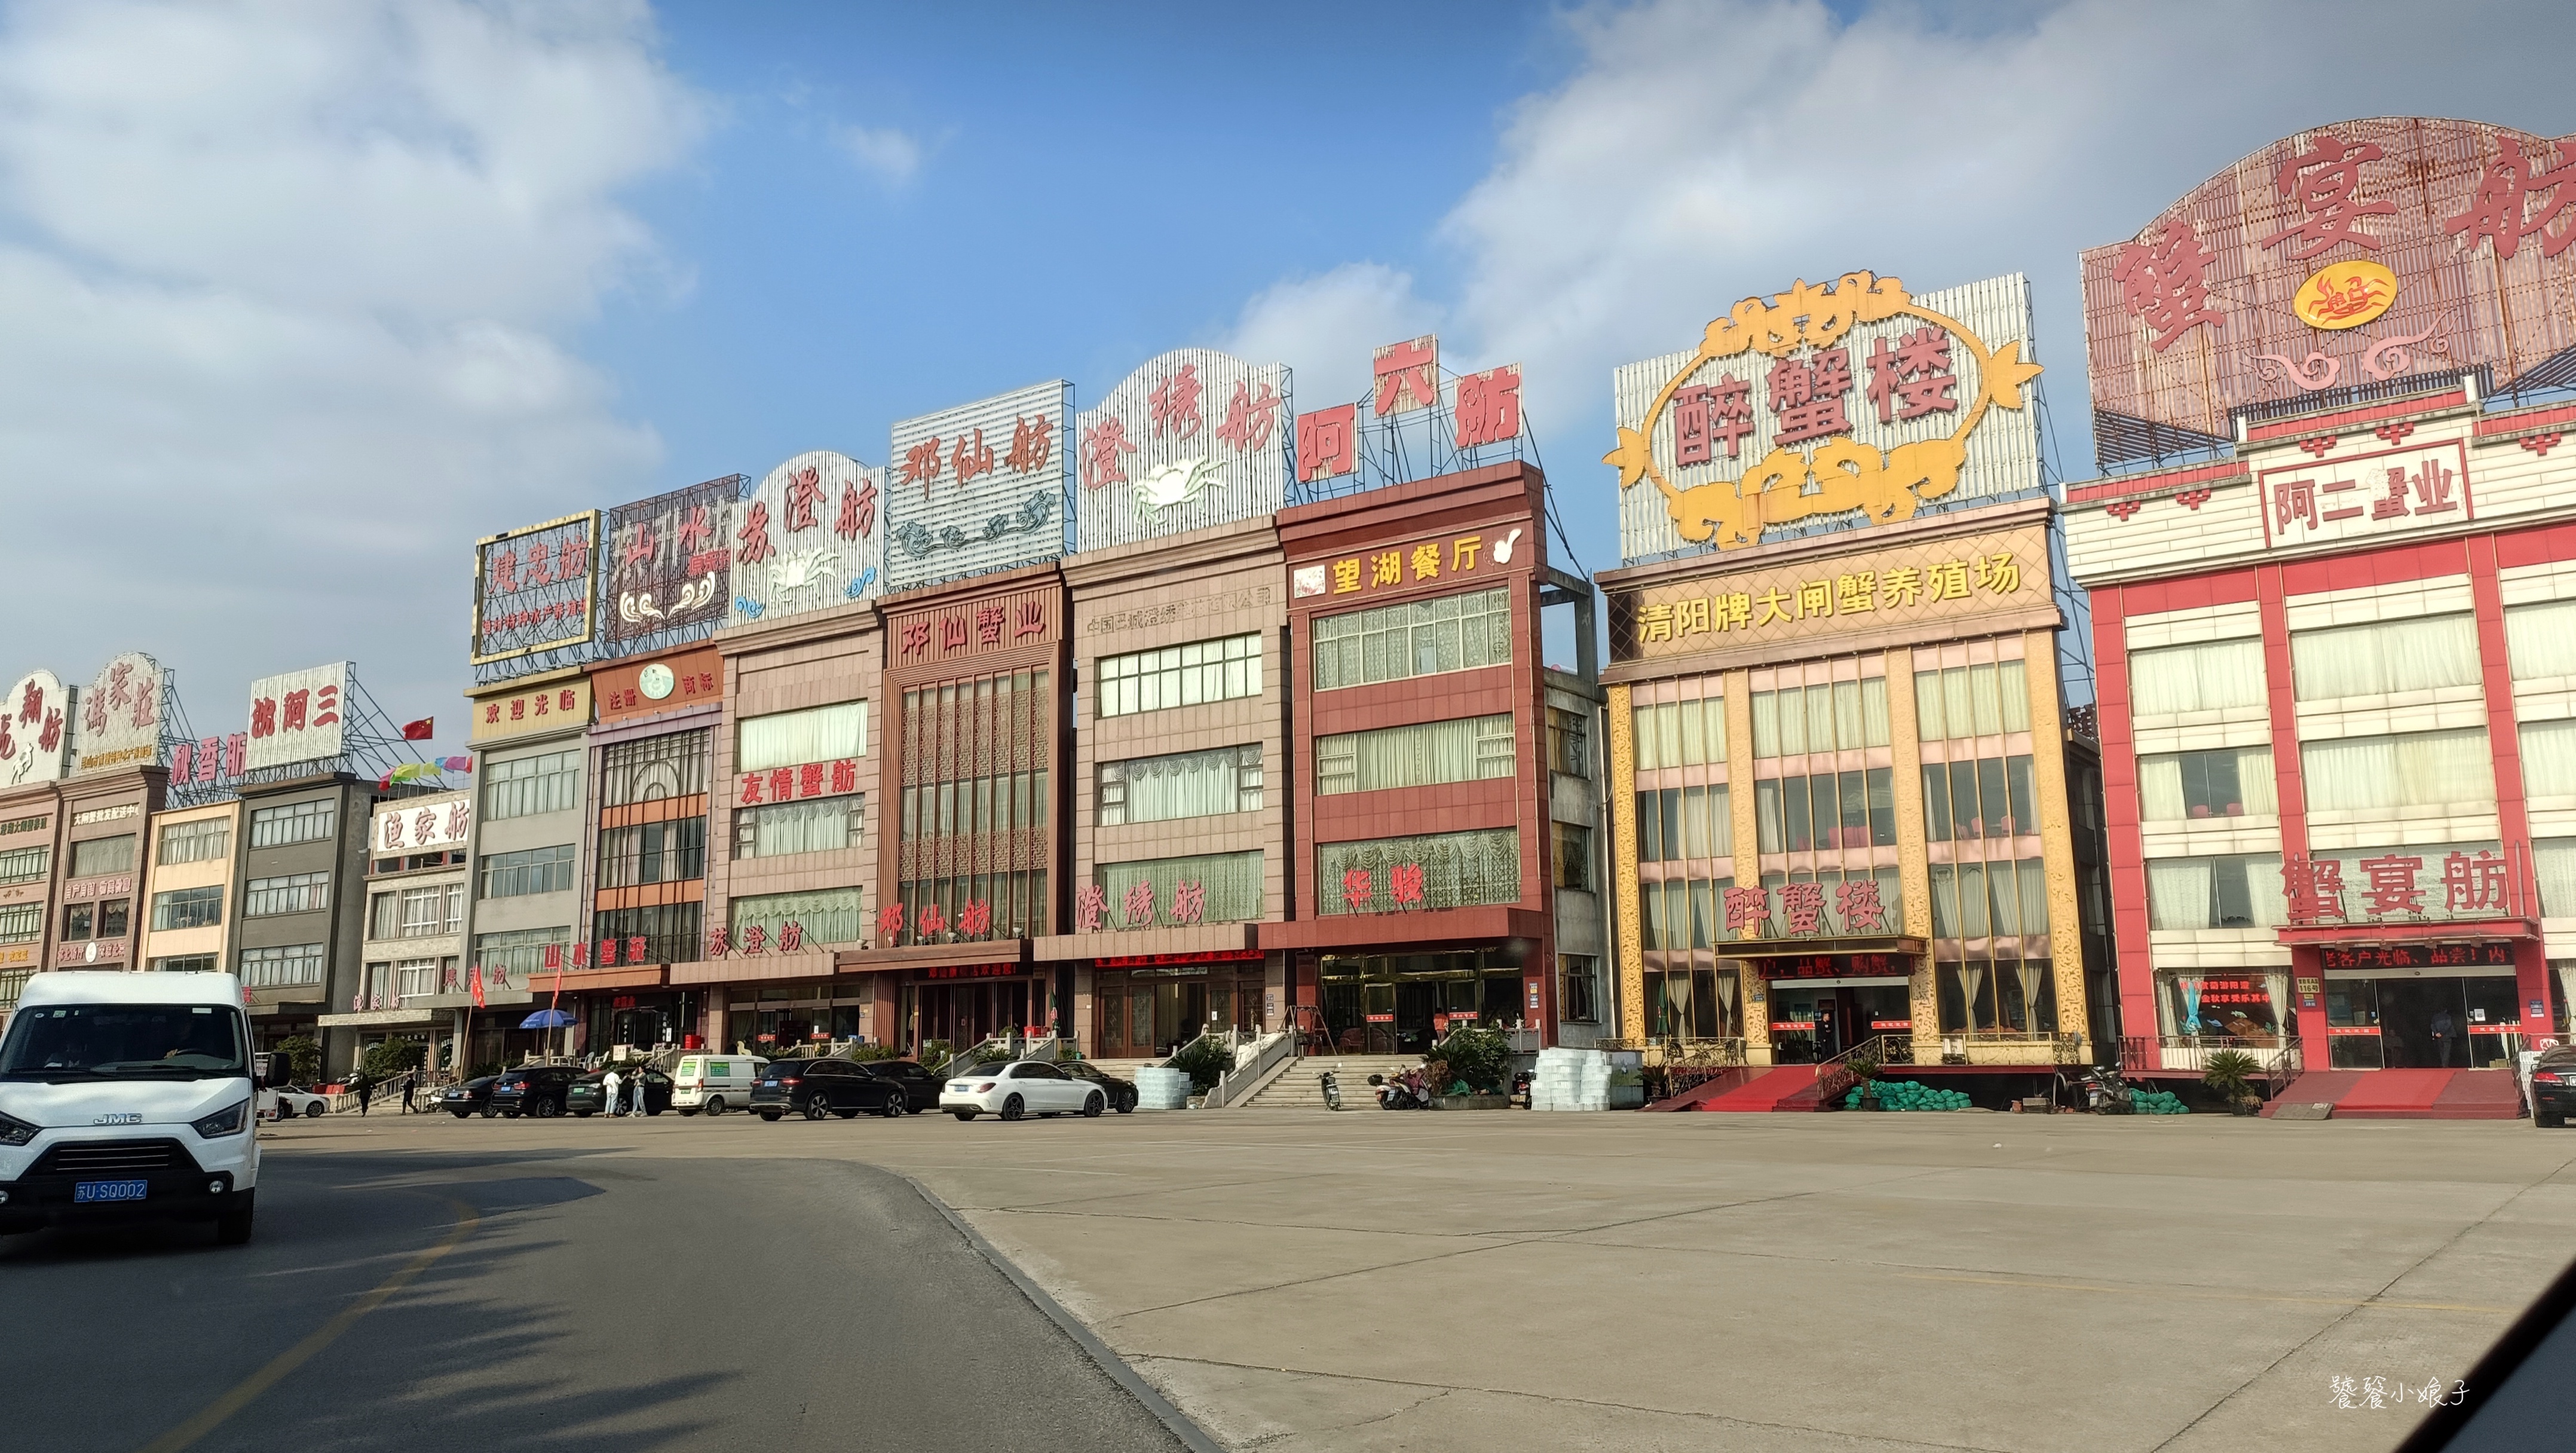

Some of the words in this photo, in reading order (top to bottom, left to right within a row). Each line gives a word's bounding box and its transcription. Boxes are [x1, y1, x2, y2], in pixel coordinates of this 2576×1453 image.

[1297, 342, 1519, 481] 阿六舫
[1673, 327, 1959, 468] 醉蟹楼
[899, 414, 1053, 500] 邓仙舫
[2274, 459, 2458, 534] 阿二蟹业
[489, 534, 589, 594] 建忠舫
[1333, 536, 1482, 595] 望湖餐厅
[1637, 552, 2021, 643] 清阳牌大闸蟹养殖场
[901, 601, 1046, 654] 邓仙蟹业
[486, 690, 575, 723] 欢迎光临
[609, 687, 636, 710] 注册
[682, 672, 714, 695] 商标
[171, 731, 247, 787] 秋香舫
[741, 758, 856, 804] 友情蟹舫
[1343, 863, 1423, 907] 华骏
[1723, 879, 1886, 936] 醉蟹楼
[2280, 849, 2508, 920] 蟹宴舫
[710, 921, 802, 956] 苏澄舫
[878, 898, 990, 946] 邓仙舫
[94, 1113, 142, 1125] JMC
